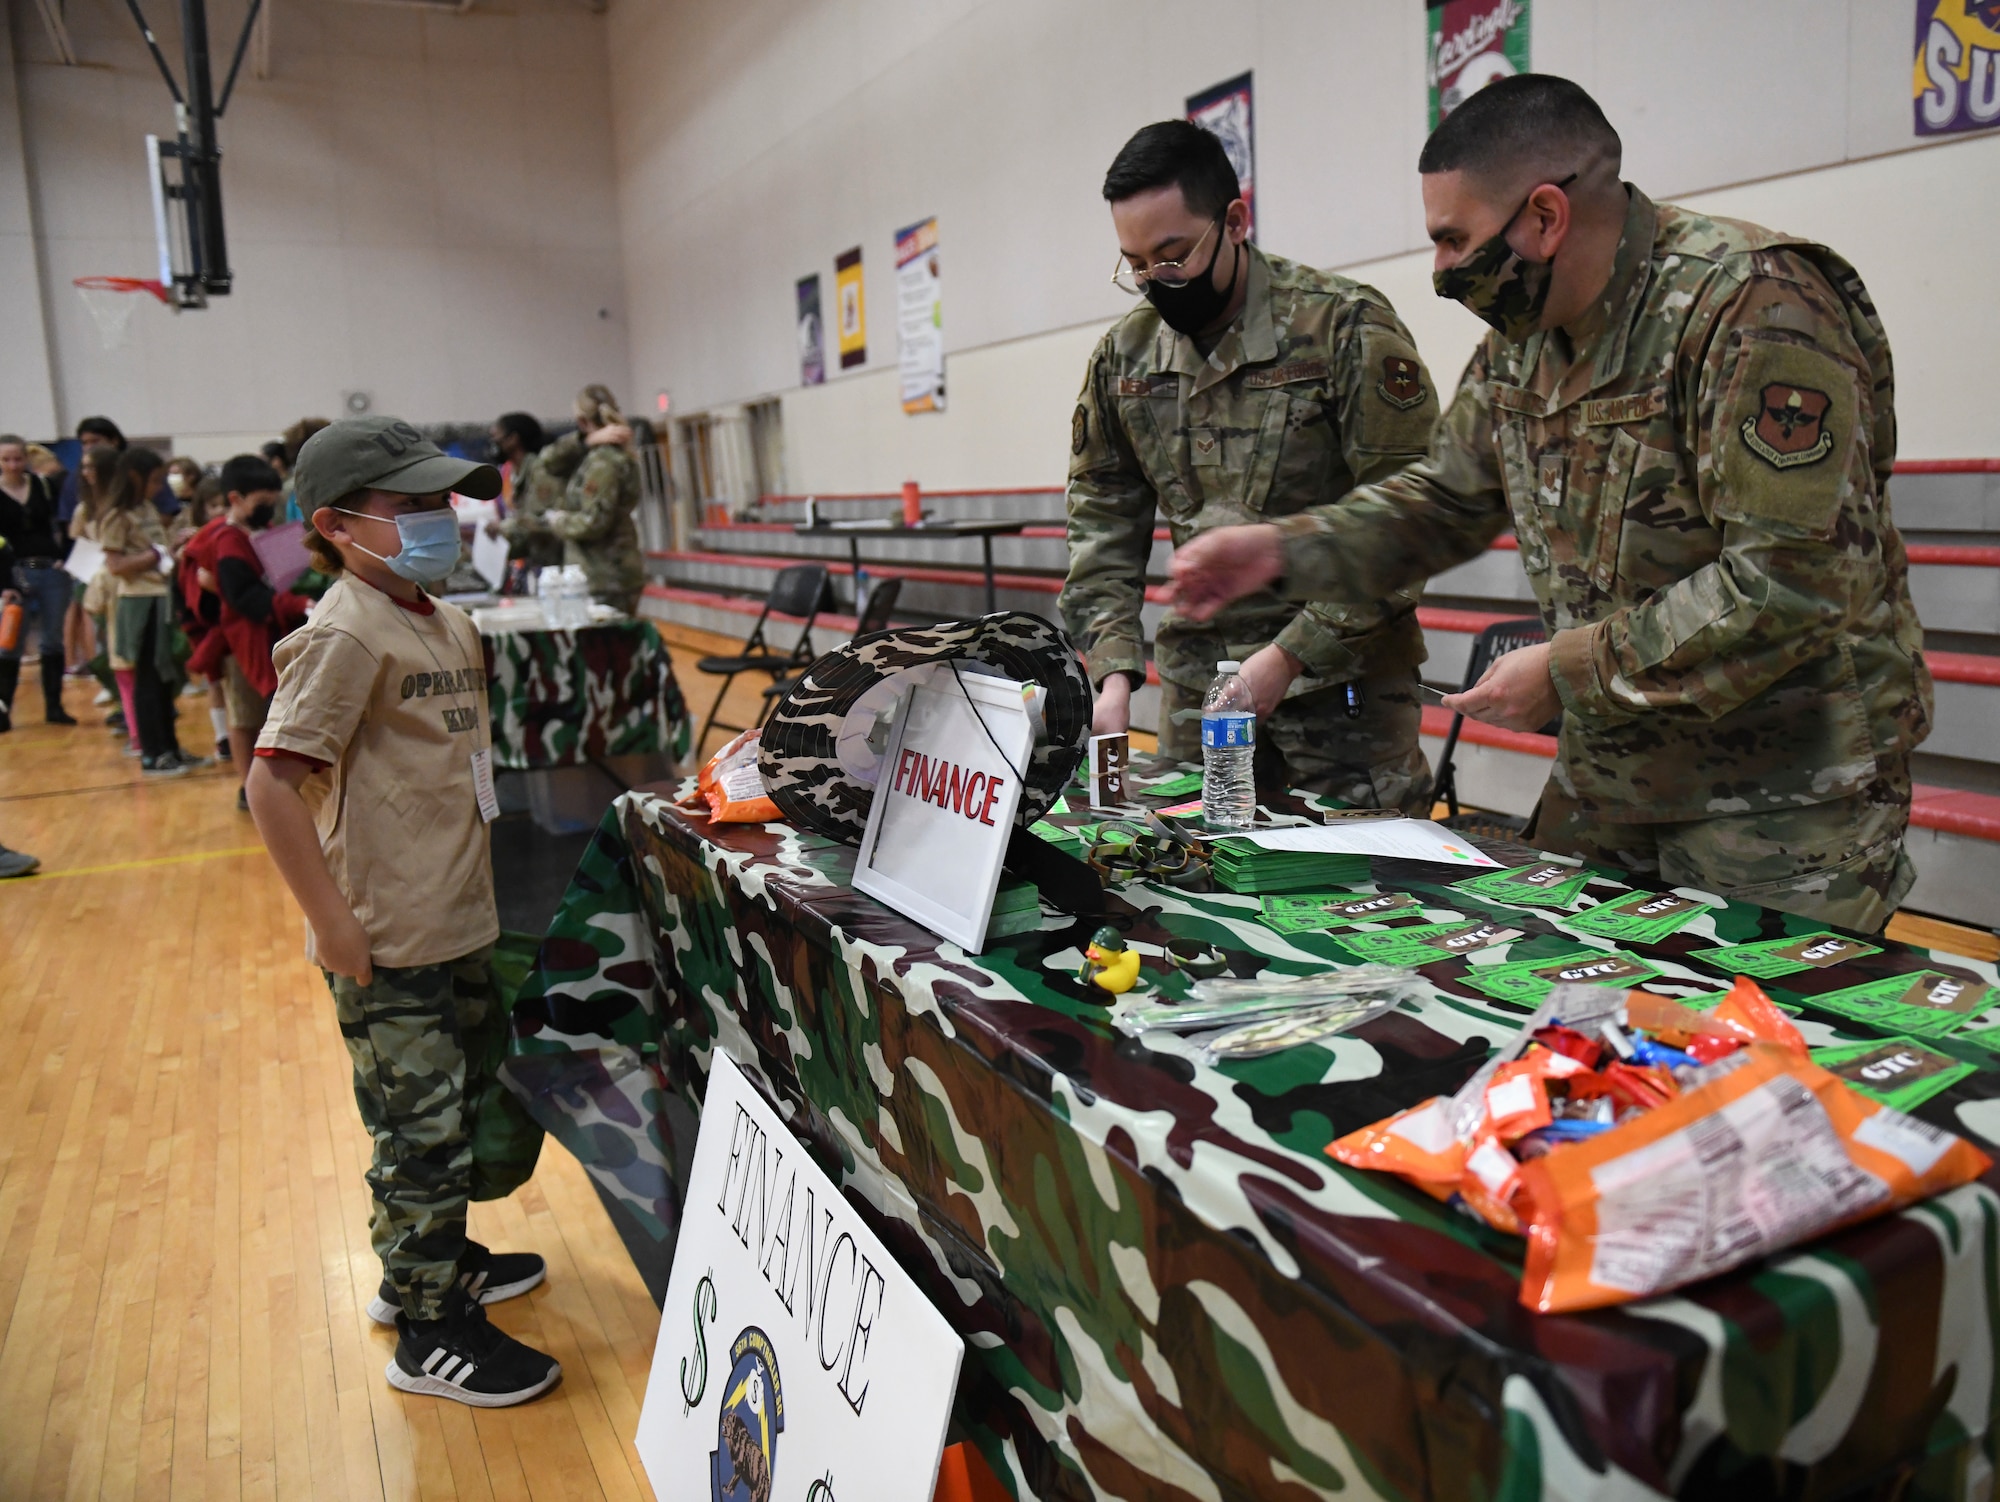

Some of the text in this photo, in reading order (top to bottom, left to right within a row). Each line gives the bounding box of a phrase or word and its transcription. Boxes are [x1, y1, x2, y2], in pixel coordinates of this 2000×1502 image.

[1587, 402, 1604, 422] U.S.
[373, 422, 422, 457] US
[1107, 747, 1120, 793] GTC
[894, 748, 1004, 827] FINANCE
[1527, 867, 1564, 883] GTC
[1345, 896, 1395, 914] GTC
[1637, 897, 1681, 914] GTC
[1446, 927, 1496, 947] GTC
[1801, 940, 1847, 959] GTC
[1559, 962, 1617, 980] GTC
[1927, 979, 1965, 1004] GTC
[1860, 1052, 1923, 1080] GTC
[717, 1101, 885, 1416] FINANCE
[735, 1336, 748, 1358] 56TH
[749, 1332, 780, 1394] COMPTROLLER
